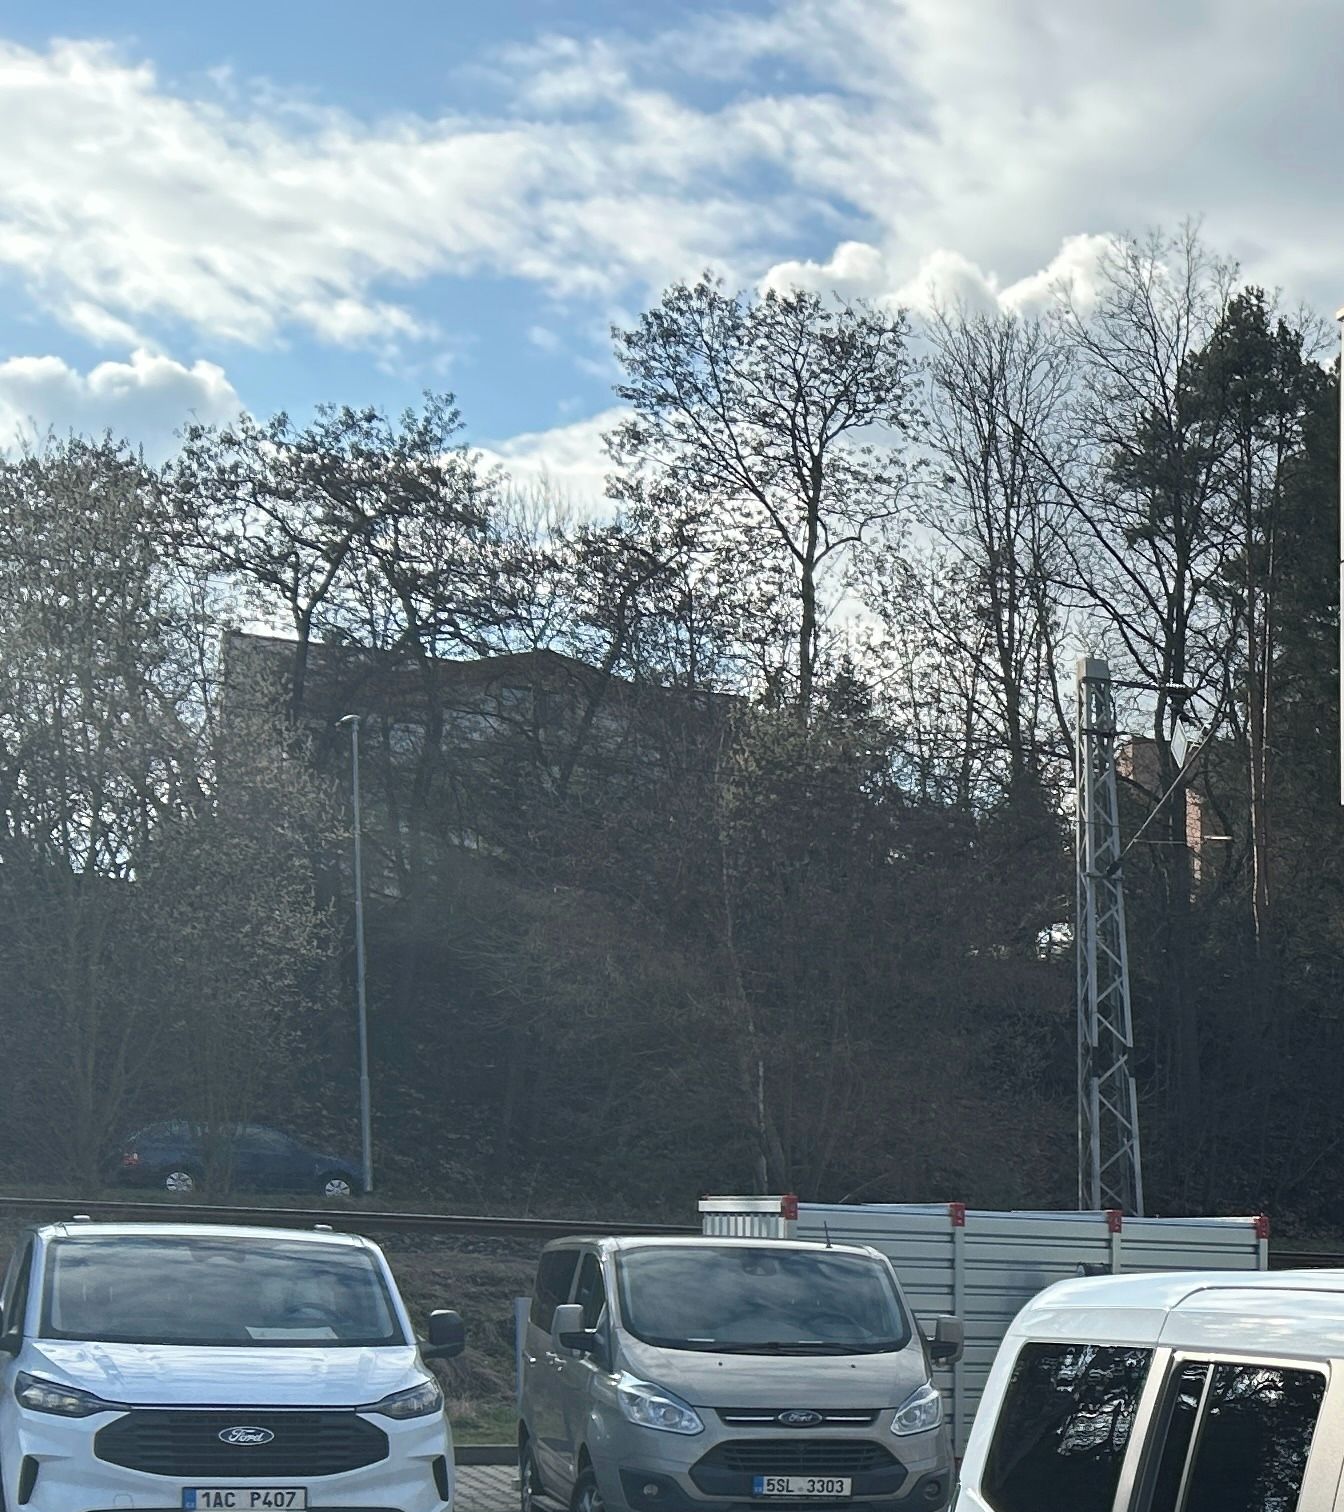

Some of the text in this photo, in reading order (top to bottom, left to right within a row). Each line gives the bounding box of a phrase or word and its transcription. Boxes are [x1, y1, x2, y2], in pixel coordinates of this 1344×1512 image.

[227, 1427, 266, 1442] Ford
[766, 1478, 794, 1493] 5SL
[806, 1479, 845, 1494] 3303
[202, 1491, 236, 1508] 1AC
[250, 1491, 297, 1508] P407
